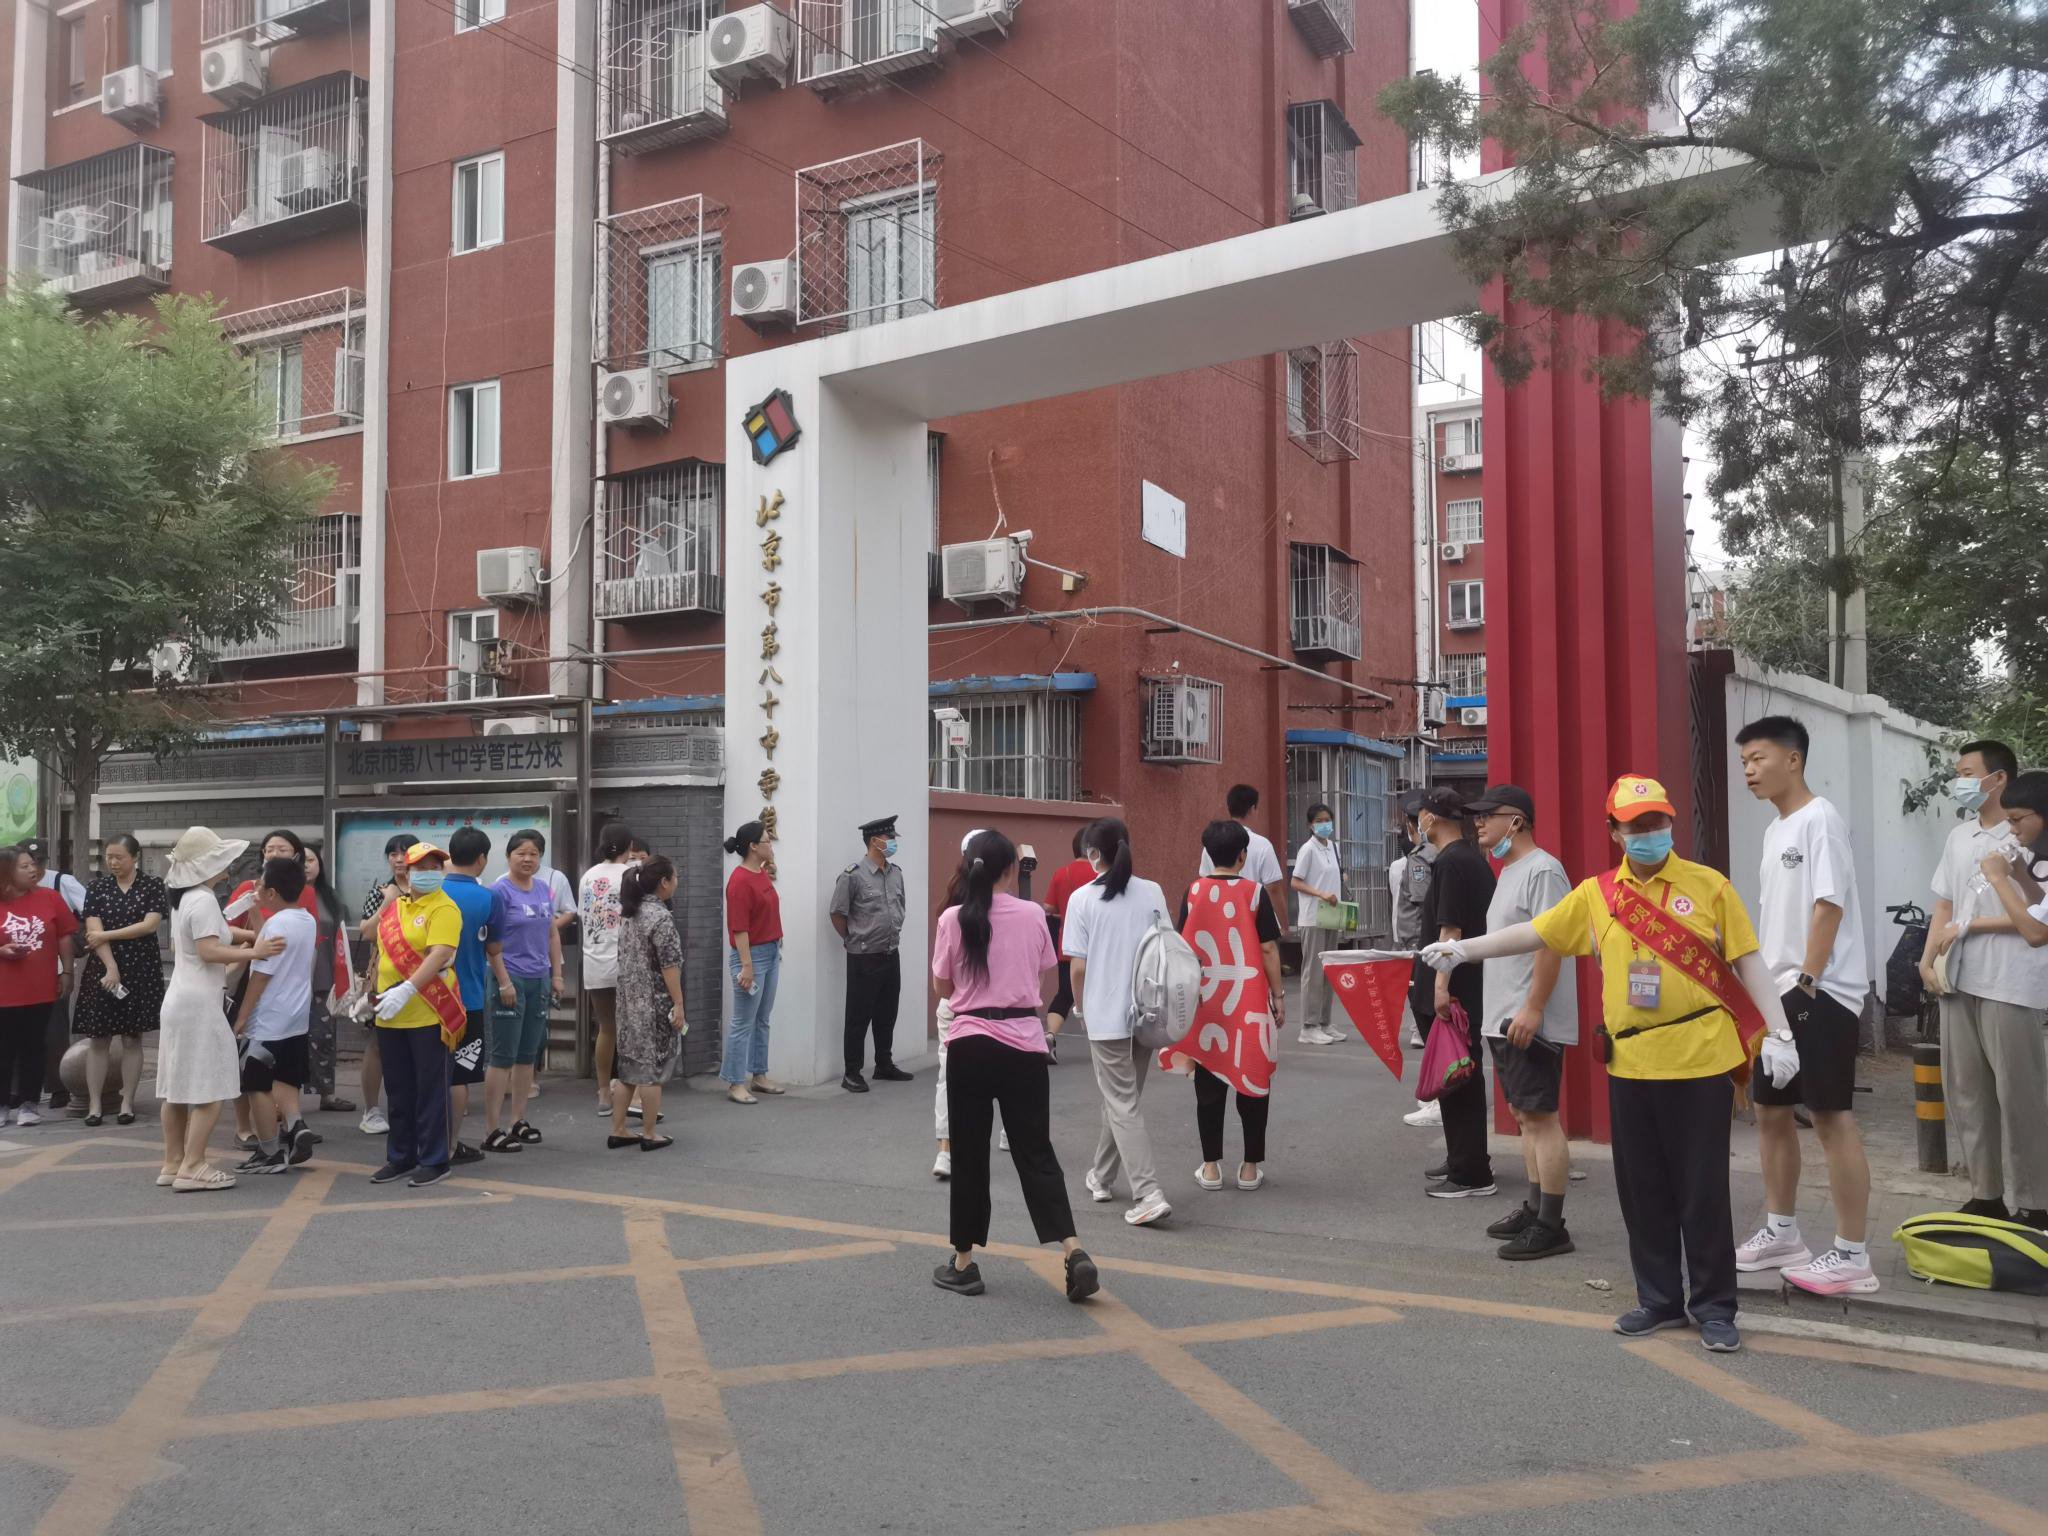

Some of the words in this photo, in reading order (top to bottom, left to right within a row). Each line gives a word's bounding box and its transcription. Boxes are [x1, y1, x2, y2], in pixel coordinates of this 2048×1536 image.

[347, 741, 563, 775] 北京市第八十中学管庄分校
[455, 1038, 482, 1060] adida
